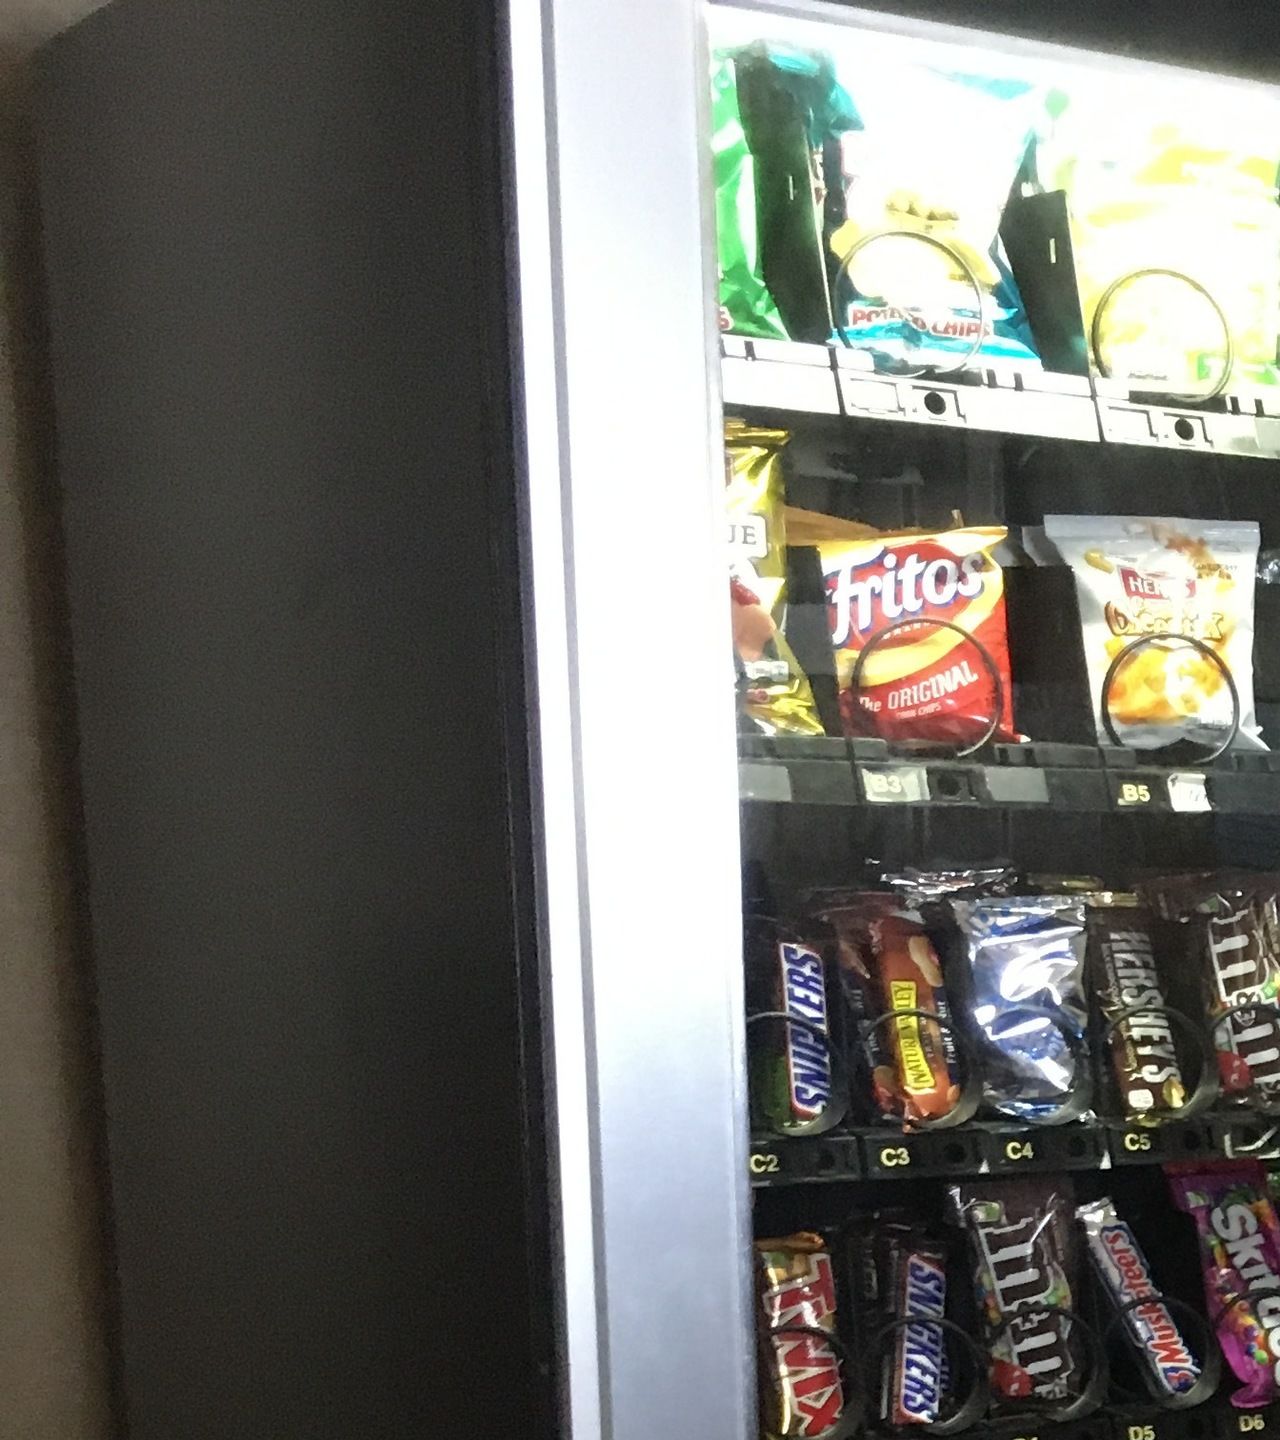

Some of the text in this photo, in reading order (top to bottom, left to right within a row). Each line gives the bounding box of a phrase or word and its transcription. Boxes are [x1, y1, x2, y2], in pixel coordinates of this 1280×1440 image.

[831, 552, 984, 645] Fritos
[888, 660, 979, 709] ORIGINAL
[918, 701, 942, 716] CHIPS
[871, 774, 902, 793] B3
[1123, 784, 1151, 802] B5
[1006, 1141, 1034, 1160] C4
[1124, 1133, 1151, 1151] C5
[750, 1154, 779, 1173] C2
[880, 1147, 910, 1167] C3
[765, 1254, 843, 1437] TWIX
[903, 1258, 946, 1417] SNICKERS
[1239, 1414, 1265, 1432] D6
